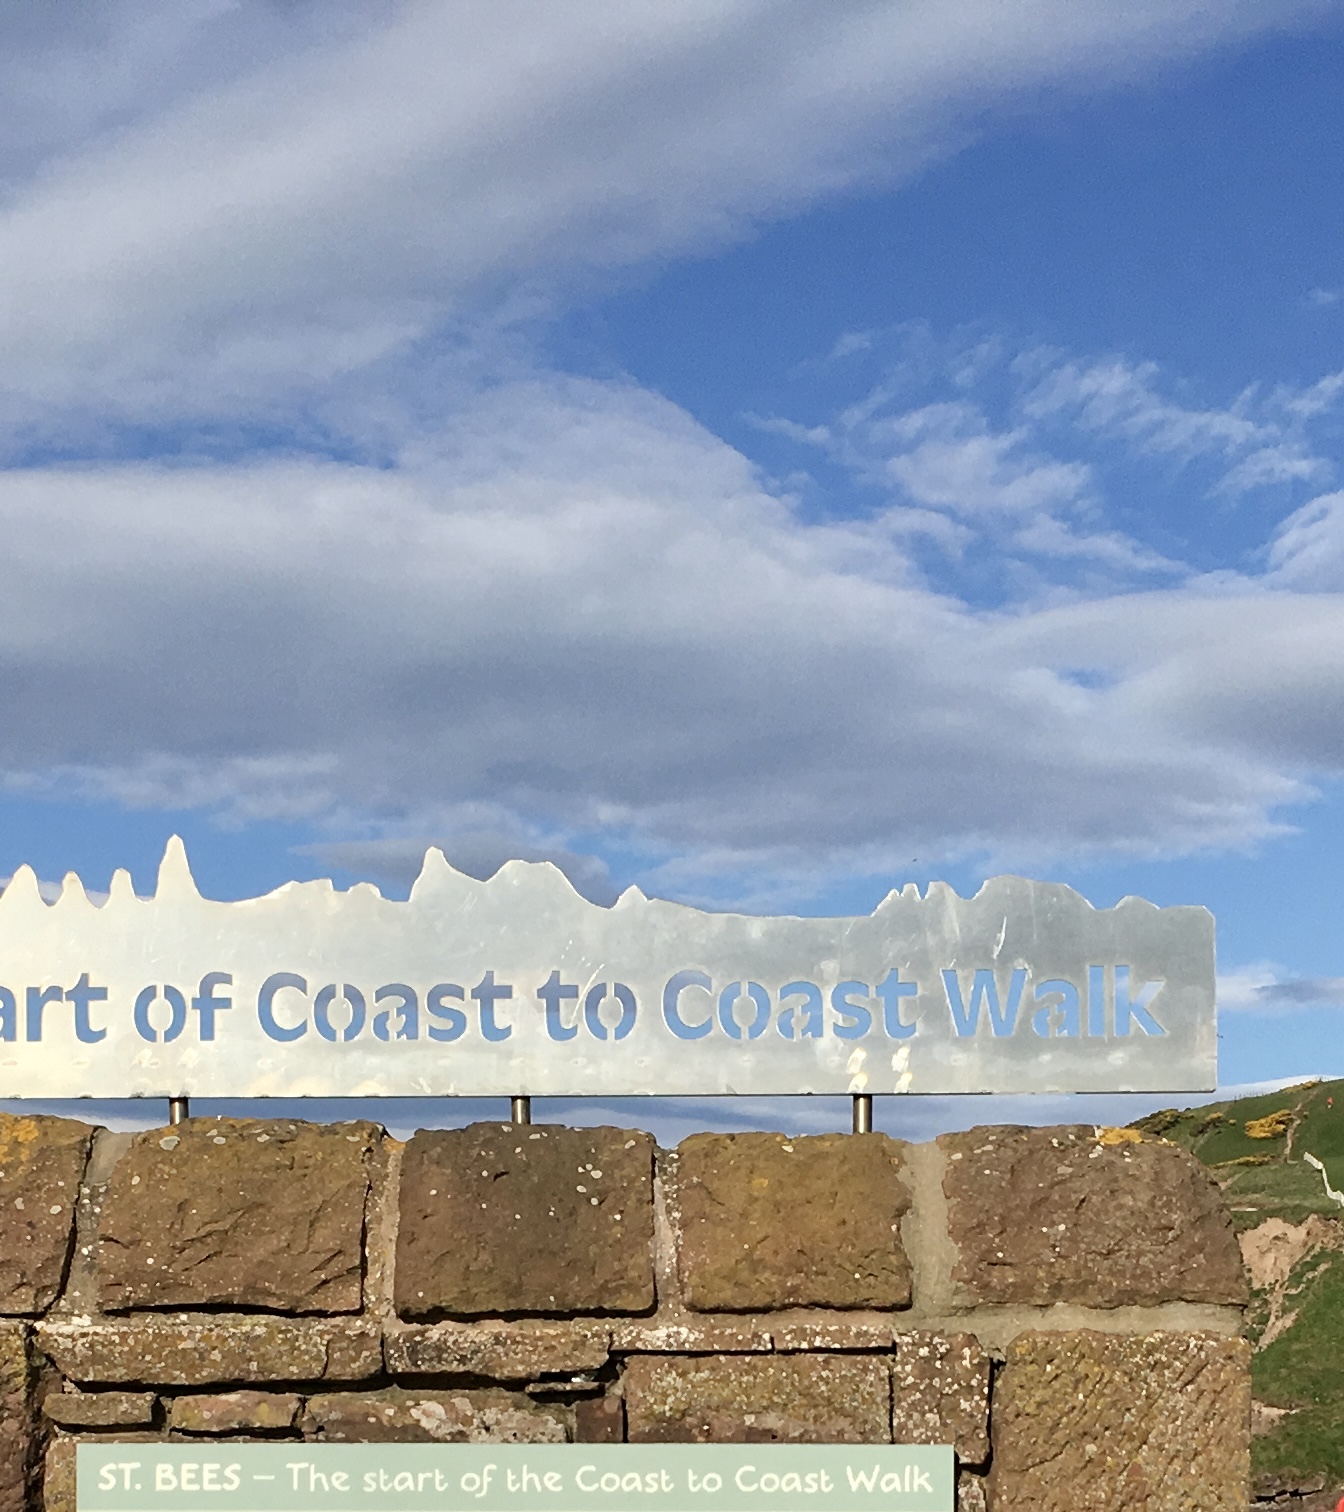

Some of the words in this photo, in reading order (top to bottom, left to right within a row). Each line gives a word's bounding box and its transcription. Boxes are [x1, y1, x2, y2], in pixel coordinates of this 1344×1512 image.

[133, 973, 233, 1044] of
[257, 973, 511, 1044] Coast
[542, 971, 638, 1043] to
[661, 970, 918, 1041] Coast
[940, 966, 1171, 1038] Walk
[98, 1462, 142, 1491] ST.
[156, 1463, 241, 1491] BEES
[286, 1462, 350, 1492] The
[362, 1467, 448, 1492] start
[460, 1464, 497, 1498] of
[507, 1464, 562, 1493] the
[575, 1465, 674, 1493] Coast
[688, 1468, 722, 1493] to
[735, 1465, 834, 1494] Coast
[846, 1465, 933, 1494] Walk
